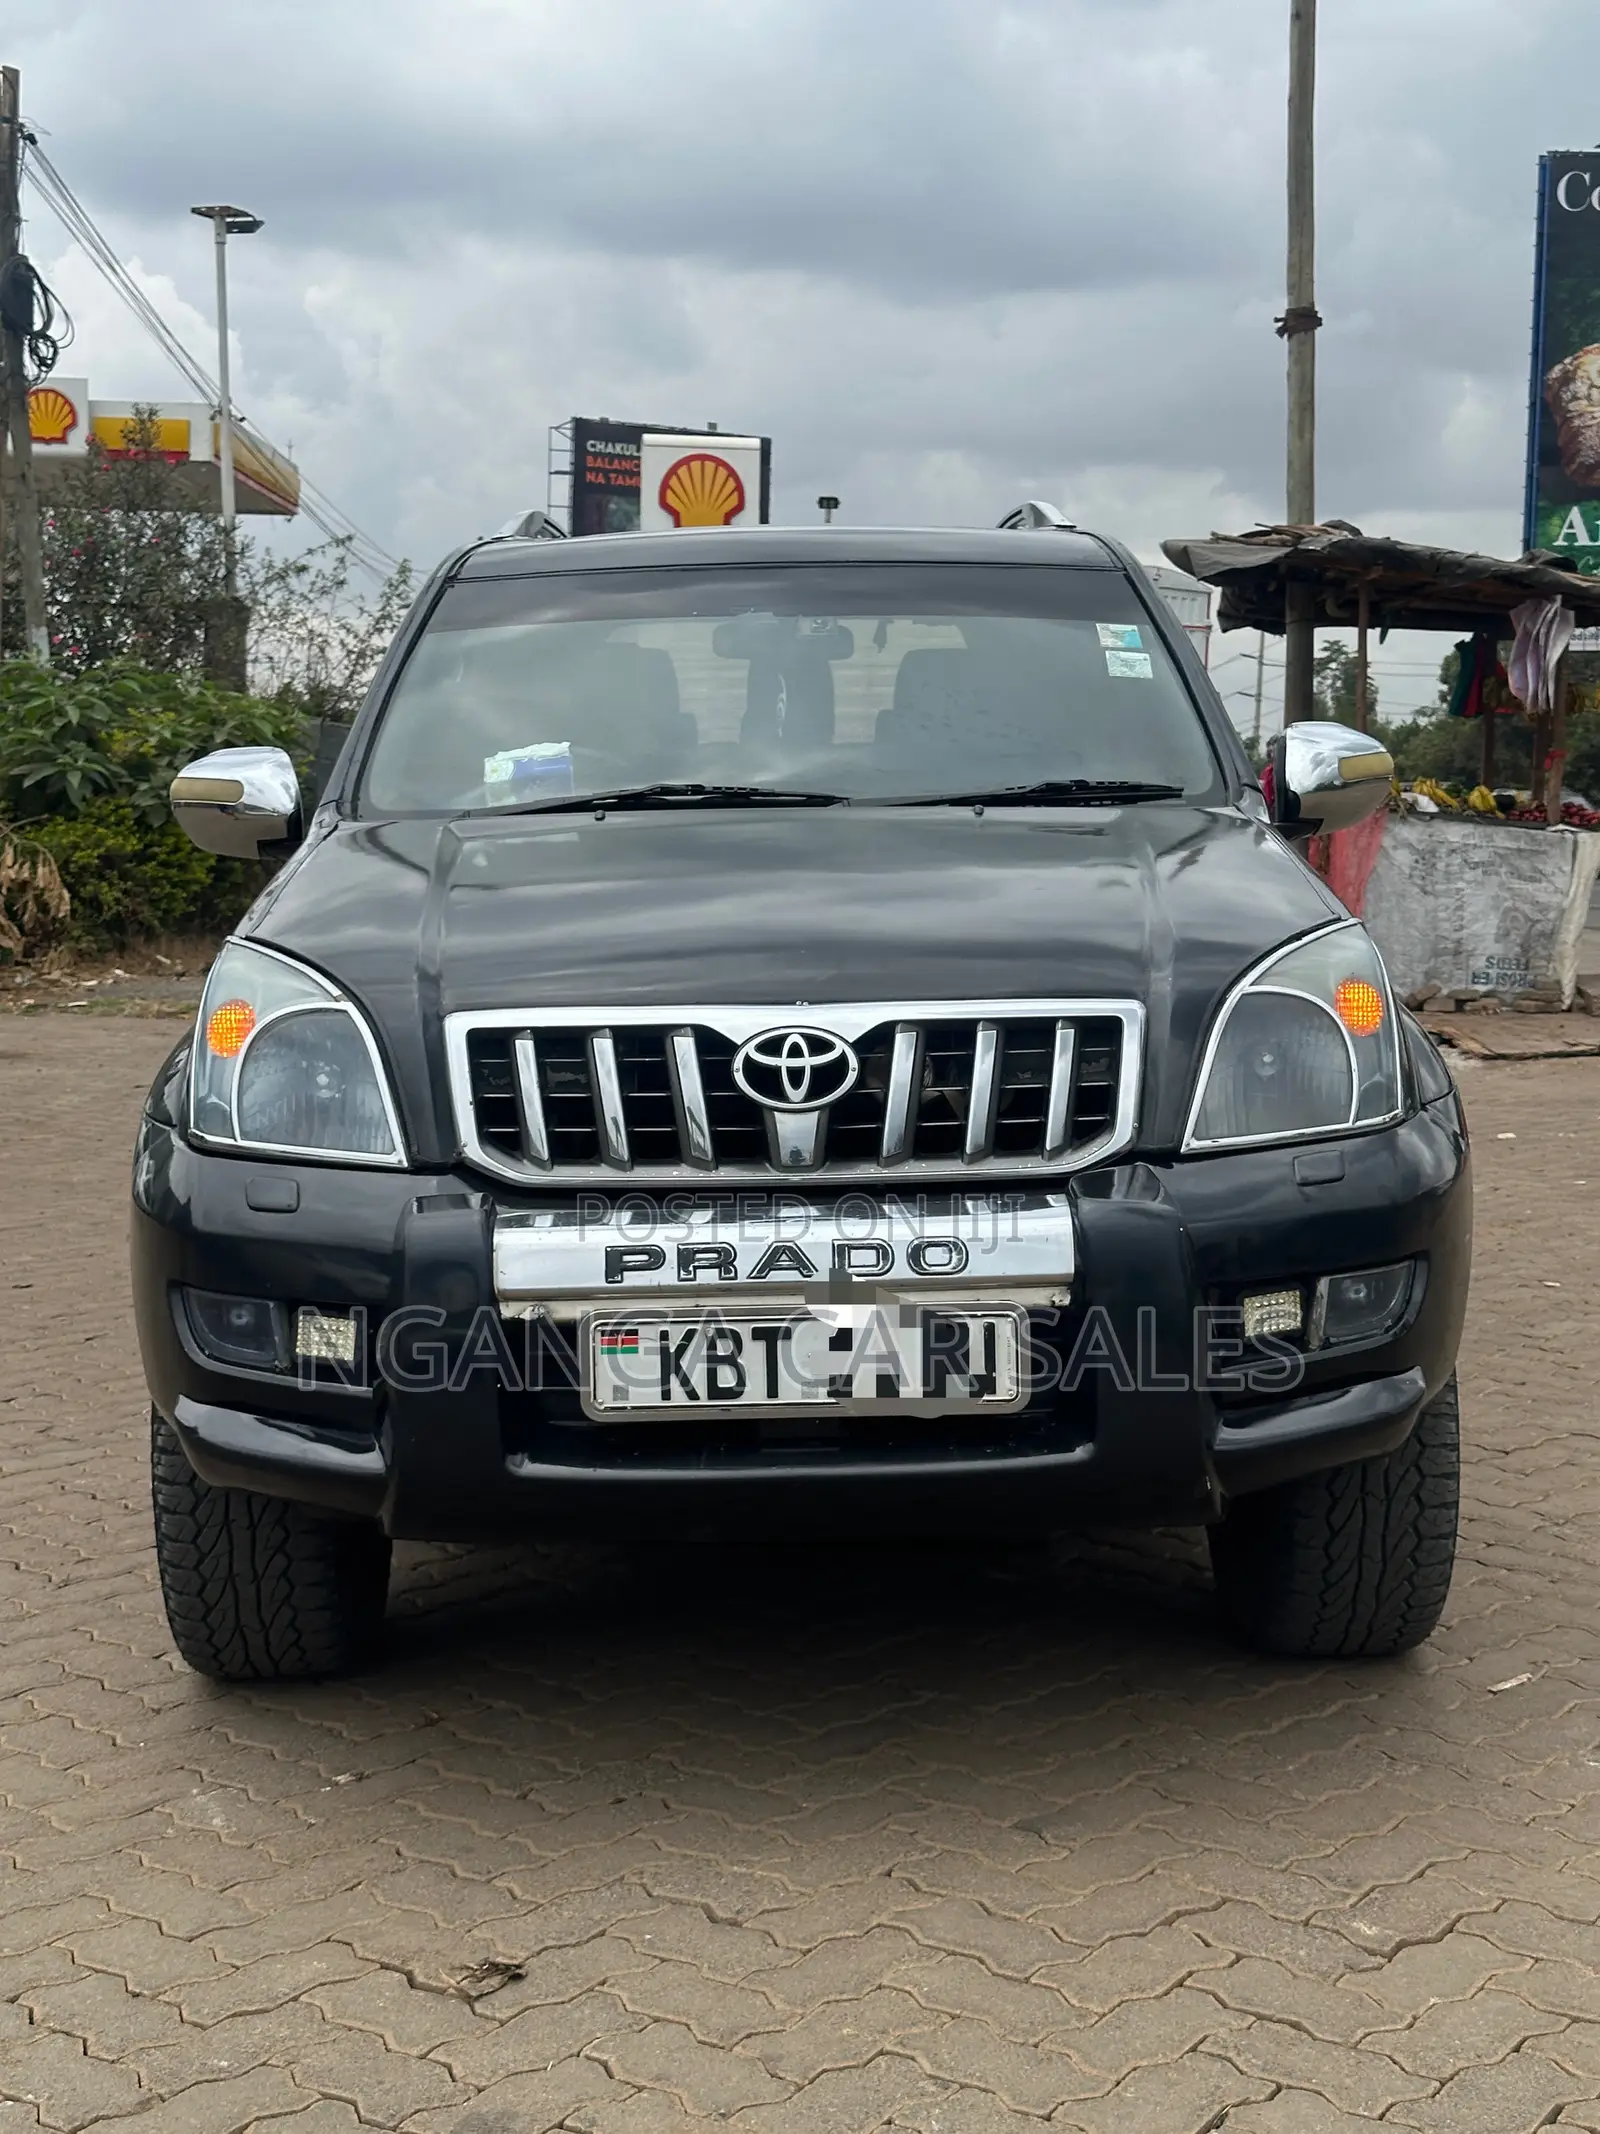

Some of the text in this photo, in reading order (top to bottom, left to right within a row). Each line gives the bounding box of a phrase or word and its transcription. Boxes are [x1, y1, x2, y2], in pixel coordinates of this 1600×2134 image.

[586, 471, 605, 484] NA
[1552, 506, 1600, 546] A
[604, 1236, 969, 1284] PRADO
[660, 1325, 792, 1402] KBT
